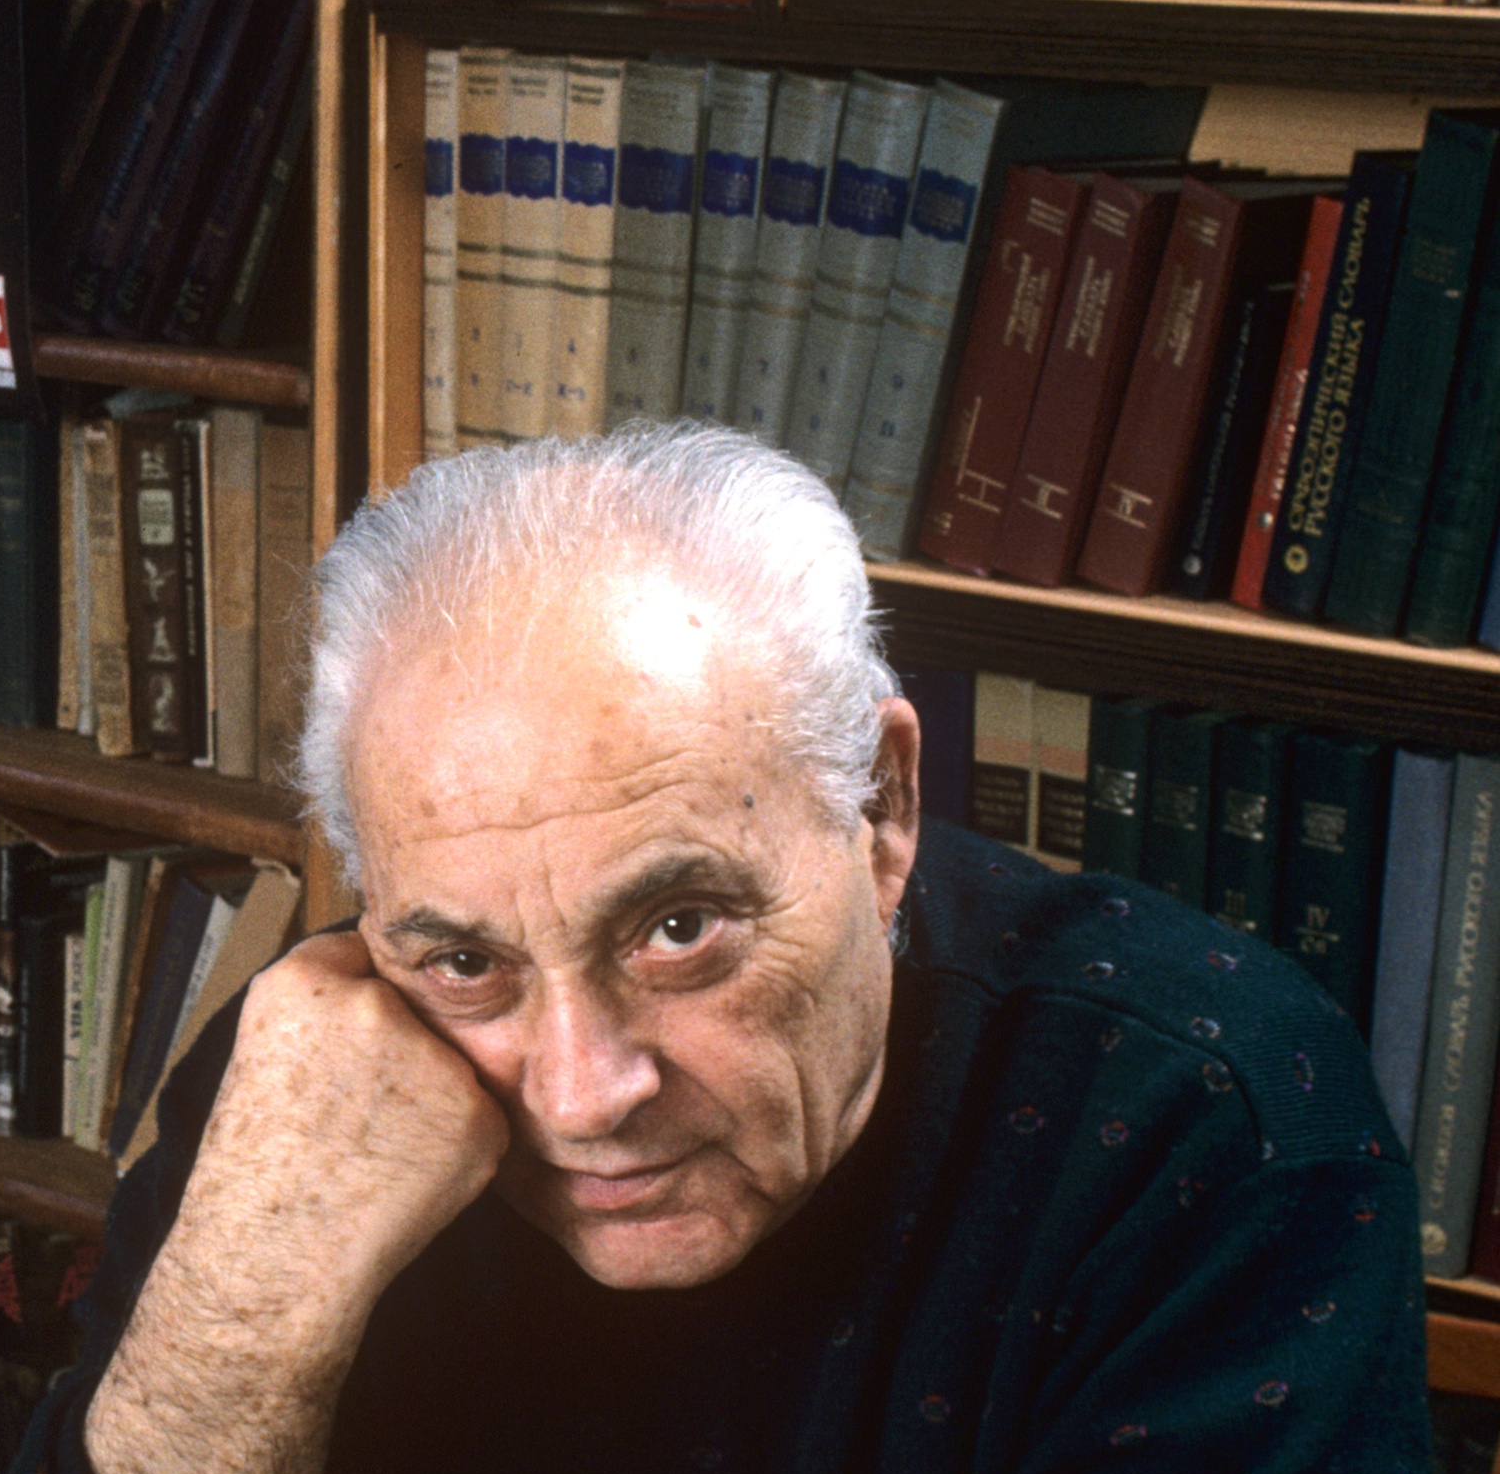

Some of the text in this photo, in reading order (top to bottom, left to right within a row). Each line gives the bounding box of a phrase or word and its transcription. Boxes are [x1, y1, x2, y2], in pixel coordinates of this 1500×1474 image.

[1337, 197, 1371, 310] СЛОВАРЬ
[1303, 318, 1366, 538] РУССКОГО ЯЗЫКА
